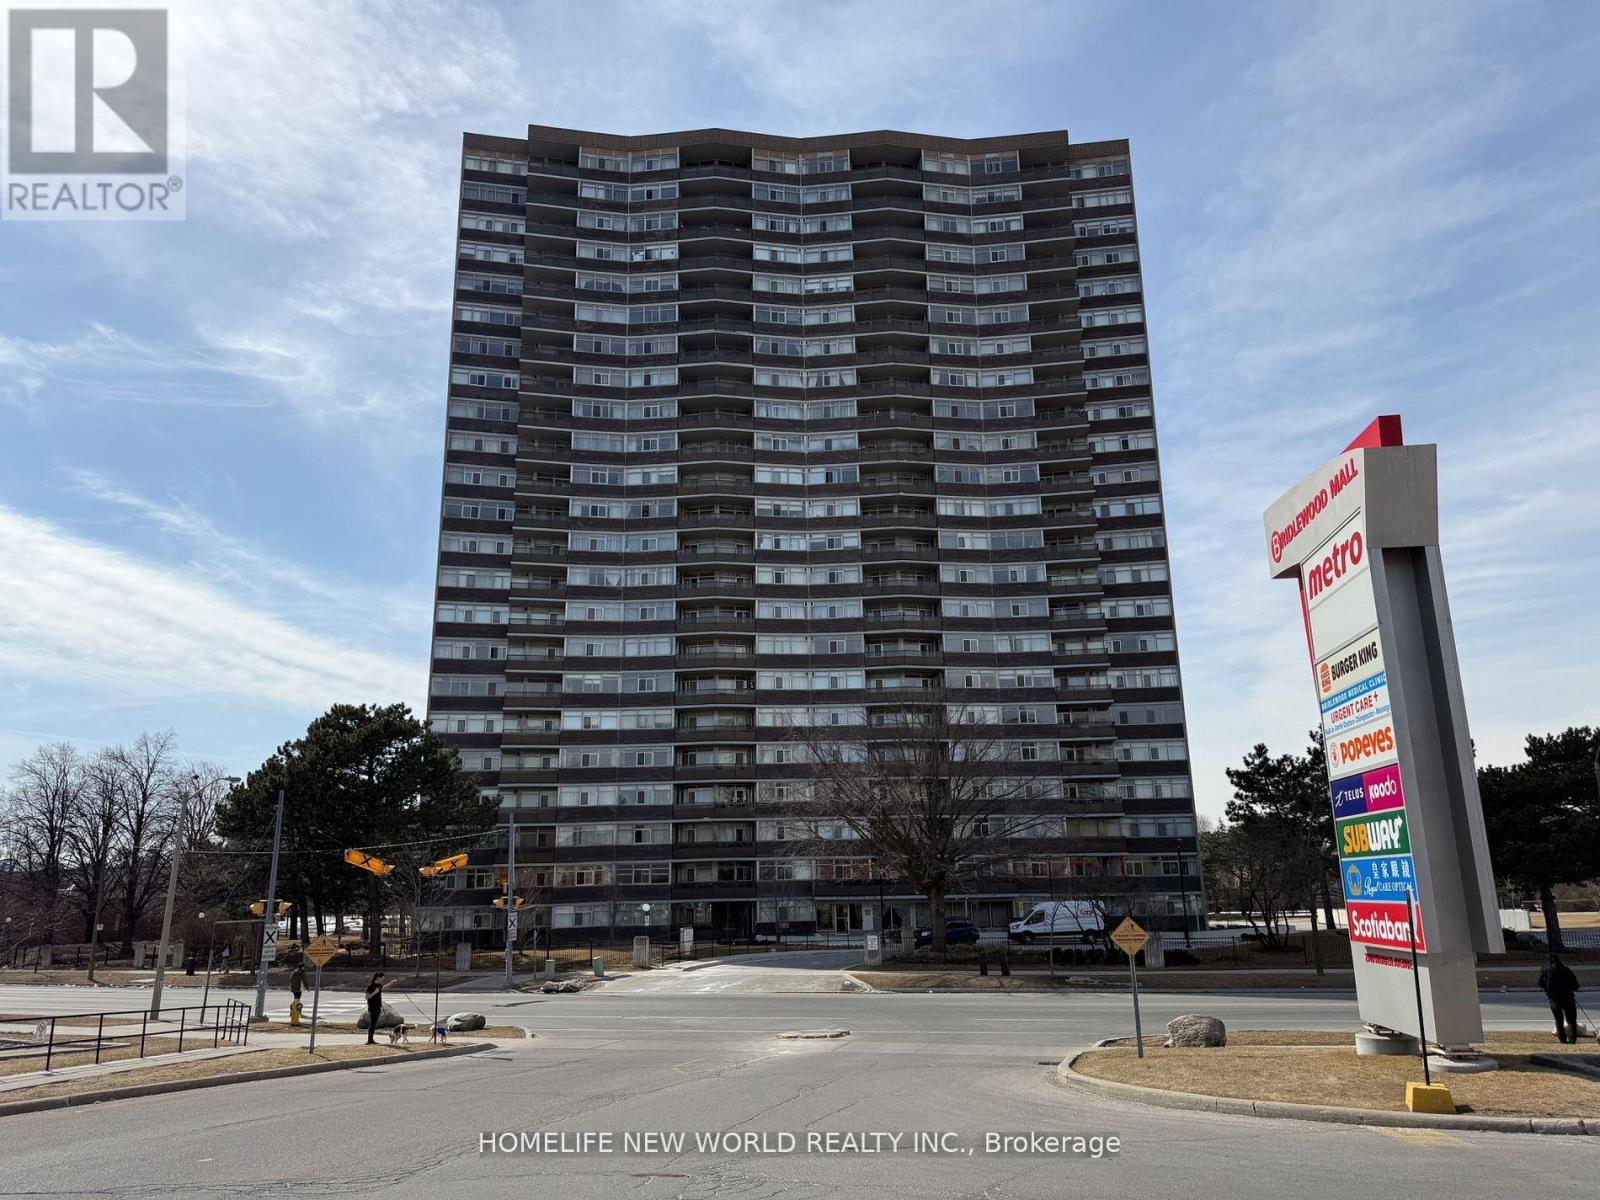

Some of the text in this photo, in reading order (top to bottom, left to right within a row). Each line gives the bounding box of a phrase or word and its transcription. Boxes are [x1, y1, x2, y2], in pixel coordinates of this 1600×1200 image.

[1271, 458, 1358, 563] BRIDLEWOOD MALL
[1308, 531, 1363, 601] metro
[1331, 653, 1359, 681] BURGER
[1359, 641, 1378, 667] KING
[1330, 694, 1374, 724] URGENT CARE
[1347, 682, 1368, 698] MEDICAL
[1344, 787, 1364, 801] TELUS
[1343, 815, 1403, 856] SUBWAY
